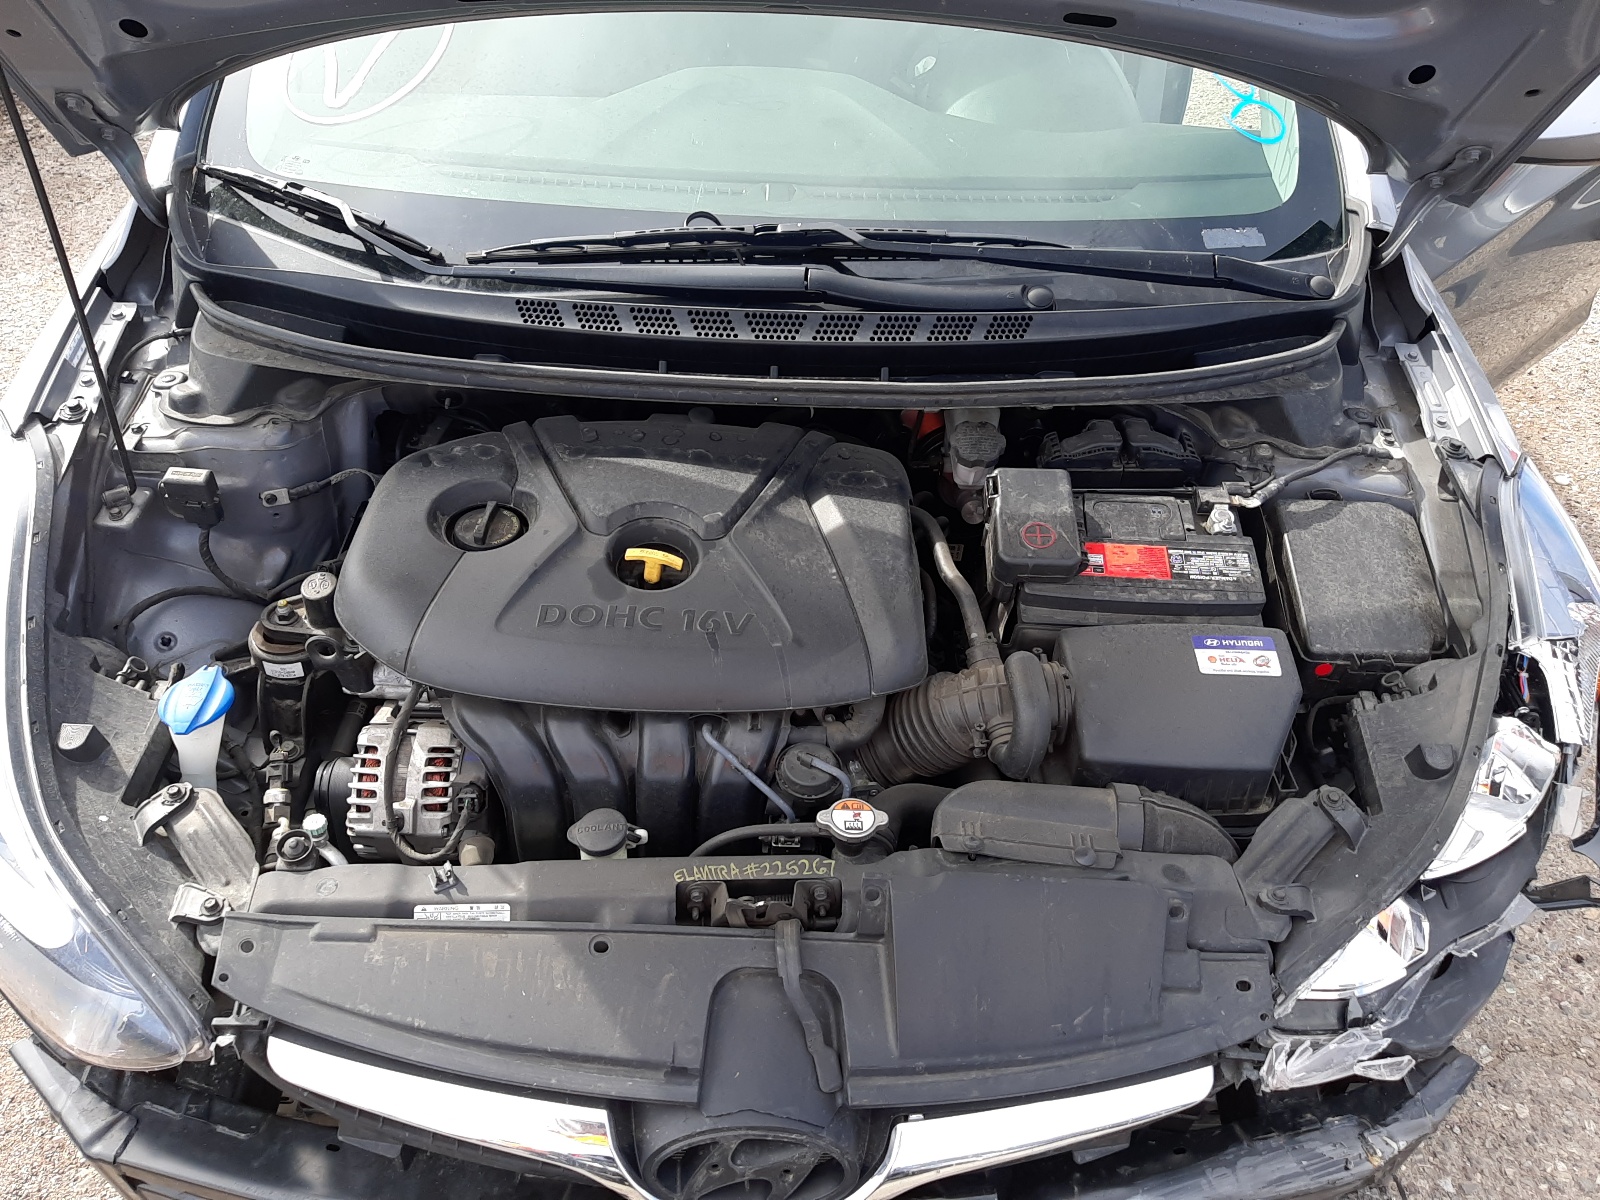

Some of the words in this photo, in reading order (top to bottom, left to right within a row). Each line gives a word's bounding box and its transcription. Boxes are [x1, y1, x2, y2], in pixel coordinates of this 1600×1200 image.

[536, 604, 665, 631] DOHC
[682, 607, 757, 635] 16V
[1221, 639, 1264, 647] HYUNDAI
[577, 823, 627, 834] COOLANT
[673, 862, 742, 883] ELANTRA
[742, 857, 836, 879] #225267
